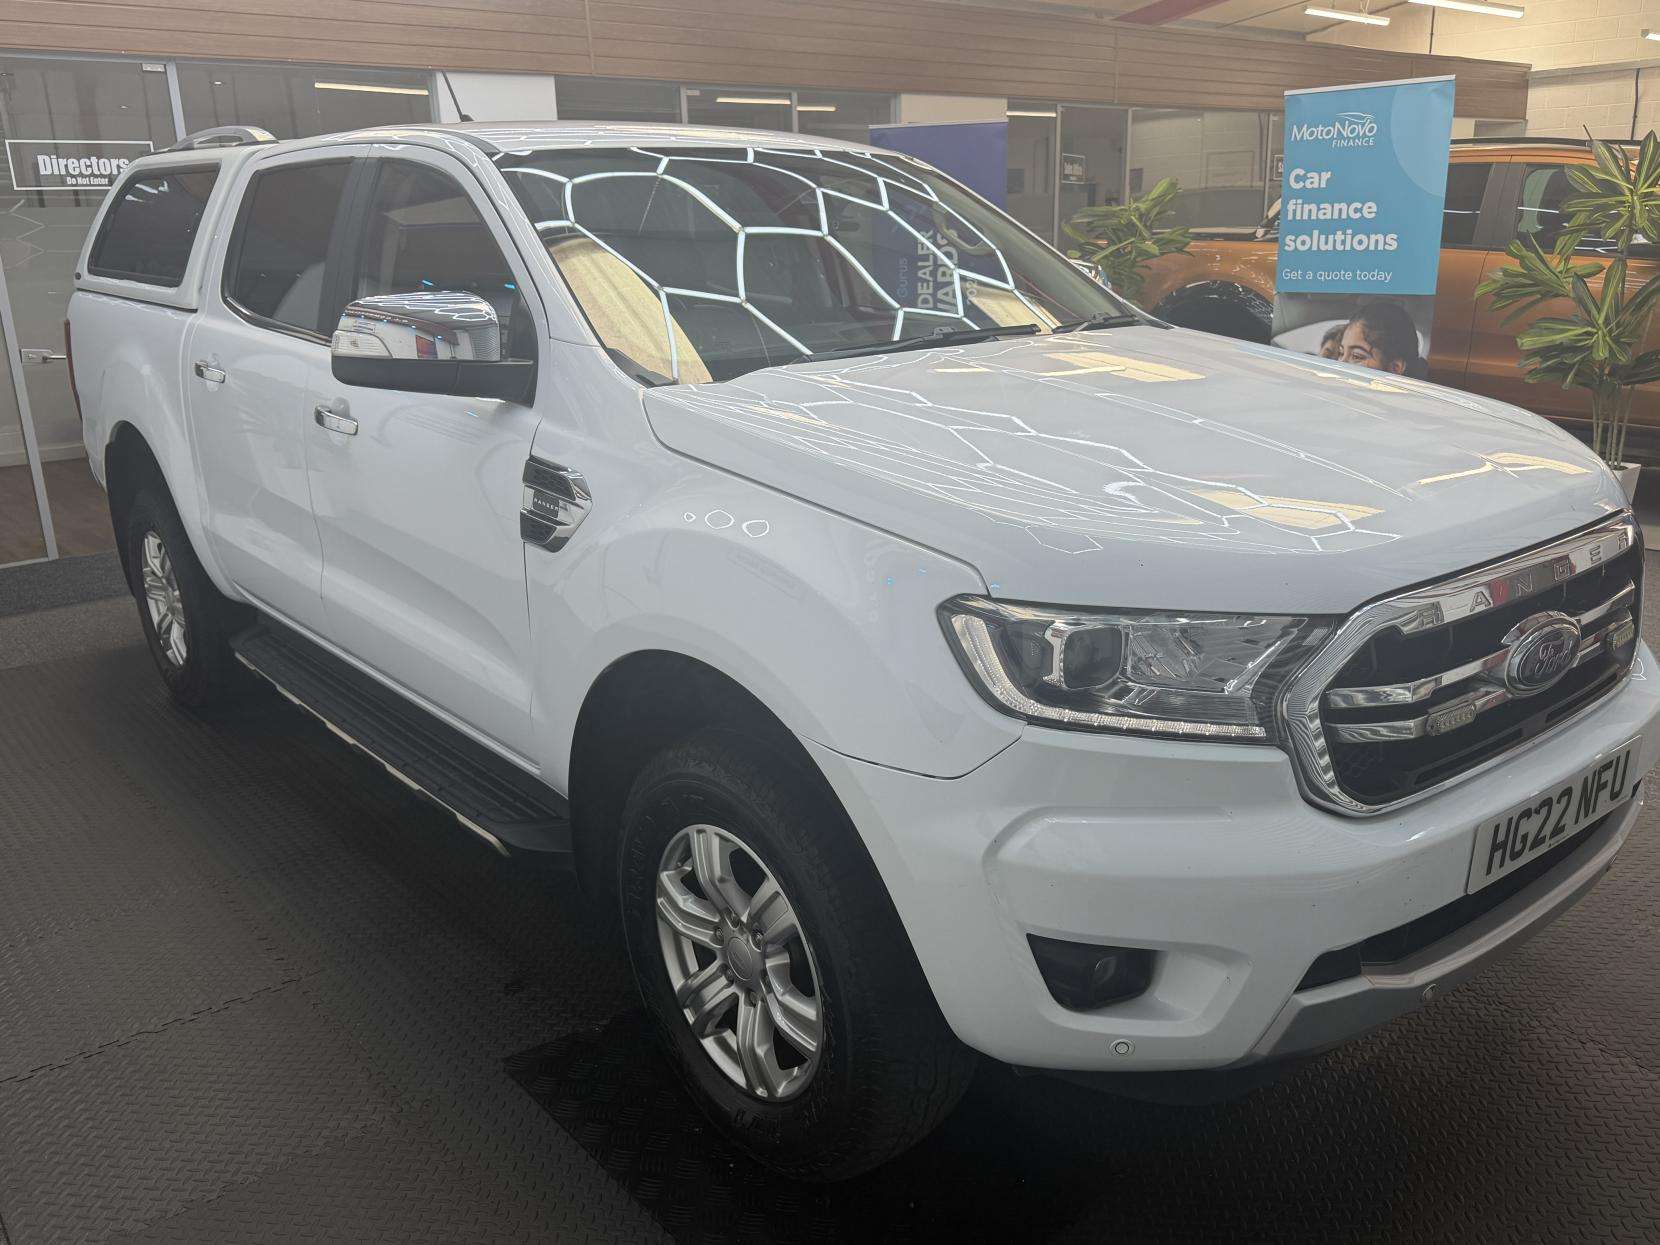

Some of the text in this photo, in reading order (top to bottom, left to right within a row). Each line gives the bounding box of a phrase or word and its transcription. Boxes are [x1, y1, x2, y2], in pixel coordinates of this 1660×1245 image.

[1291, 120, 1377, 141] MotoNovo
[1332, 138, 1375, 148] FINANCE
[37, 154, 129, 175] Directors
[67, 176, 76, 184] Do
[1289, 168, 1331, 189] Car
[1287, 199, 1377, 220] finance
[1284, 229, 1398, 251] solutions
[1282, 269, 1392, 282] Get a quote today
[1417, 532, 1628, 626] RANGER
[1533, 637, 1574, 676] Ford
[1486, 749, 1630, 876] HG22 NFU
